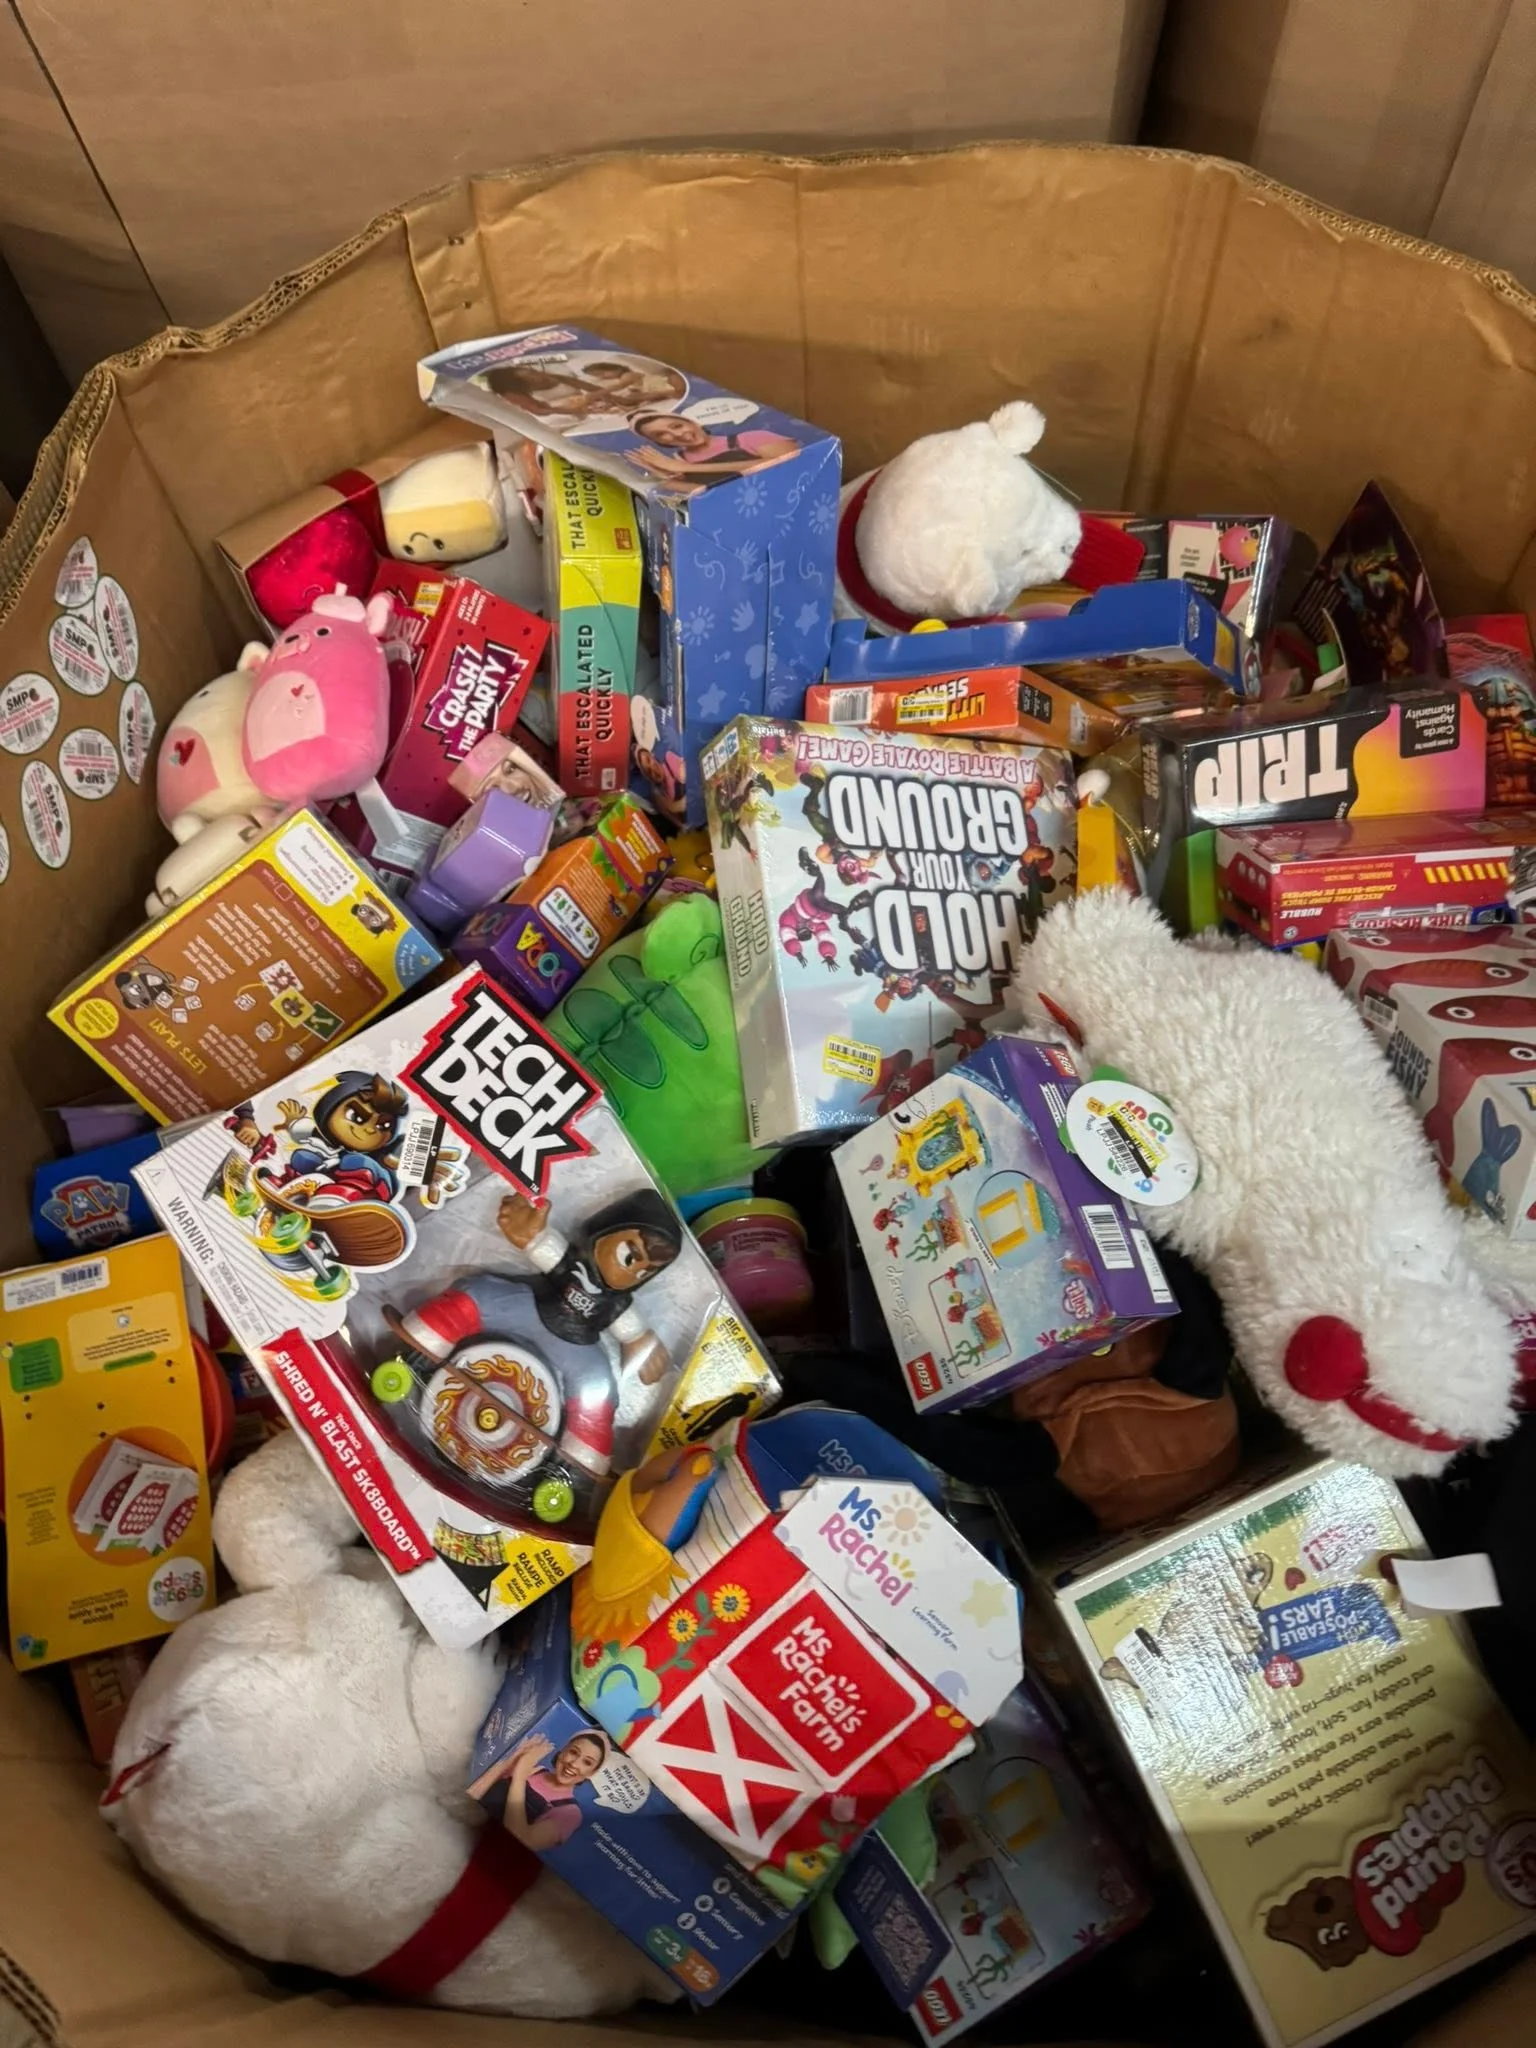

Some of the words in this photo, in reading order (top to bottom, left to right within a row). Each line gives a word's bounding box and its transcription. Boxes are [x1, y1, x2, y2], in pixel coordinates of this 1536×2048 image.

[565, 512, 586, 548] THAT
[63, 628, 88, 647] SMP
[462, 654, 510, 726] PARTY
[571, 624, 598, 728] ESCALATED
[5, 691, 29, 710] SMP
[436, 656, 484, 731] CRASH
[592, 667, 616, 740] QUICKLY
[1404, 703, 1455, 718] Humanity
[1414, 713, 1455, 728] Against
[457, 725, 480, 752] THE
[1423, 724, 1454, 736] Cards
[574, 736, 591, 777] THAT
[796, 735, 867, 767] GAME!
[872, 743, 942, 775] ROYALE
[949, 752, 1018, 781] BATTLE
[85, 773, 105, 783] SMP
[1020, 760, 1035, 784] A
[1191, 724, 1347, 812] TRIP
[826, 774, 1029, 856] GROUND
[906, 851, 970, 891] YOUR
[745, 889, 772, 954] HOLD
[1279, 907, 1322, 919] RUBBLE
[725, 896, 754, 976] GROUND
[871, 887, 1022, 974] HOLD
[149, 1016, 181, 1049] PLAY!
[449, 995, 581, 1124] TECH
[1054, 1048, 1074, 1076] LEGO
[427, 1039, 566, 1175] DECK
[430, 1145, 437, 1156] LP
[39, 1180, 134, 1233] PAW
[74, 1219, 122, 1238] PATROL
[168, 1197, 215, 1264] WARNING:
[725, 1317, 741, 1334] BIG
[736, 1335, 752, 1353] AIR
[913, 1358, 934, 1393] LEGO
[271, 1351, 317, 1403] SHRED
[318, 1420, 362, 1469] BLAST
[333, 1412, 351, 1431] Tech
[345, 1429, 364, 1449] Deck
[839, 1487, 888, 1537] Ms.
[517, 1551, 543, 1588] RAMPE
[541, 1547, 563, 1578] RAMP
[819, 1510, 914, 1605] Rachel
[910, 1605, 942, 1636] Learning
[938, 1631, 958, 1651] Farm
[925, 1607, 955, 1637] Sensory
[1279, 1610, 1357, 1646] POSEABLE
[791, 1616, 837, 1662] Ms.
[1354, 1672, 1373, 1687] for
[1372, 1653, 1409, 1677] ready
[773, 1632, 869, 1734] Rachel's
[1371, 1676, 1411, 1704] cuddly
[779, 1680, 849, 1753] Farm
[1317, 1710, 1346, 1732] Soft,
[1347, 1697, 1371, 1716] fun.
[1336, 1731, 1356, 1747] for
[1356, 1717, 1383, 1736] ears
[1291, 1740, 1337, 1768] endless
[1323, 1744, 1378, 1778] adorable
[1220, 1764, 1293, 1806] expressions
[1296, 1770, 1324, 1792] pets
[1323, 1776, 1365, 1805] classic
[1266, 1787, 1298, 1809] have
[1274, 1796, 1324, 1829] puppies
[1244, 1823, 1277, 1847] ever!
